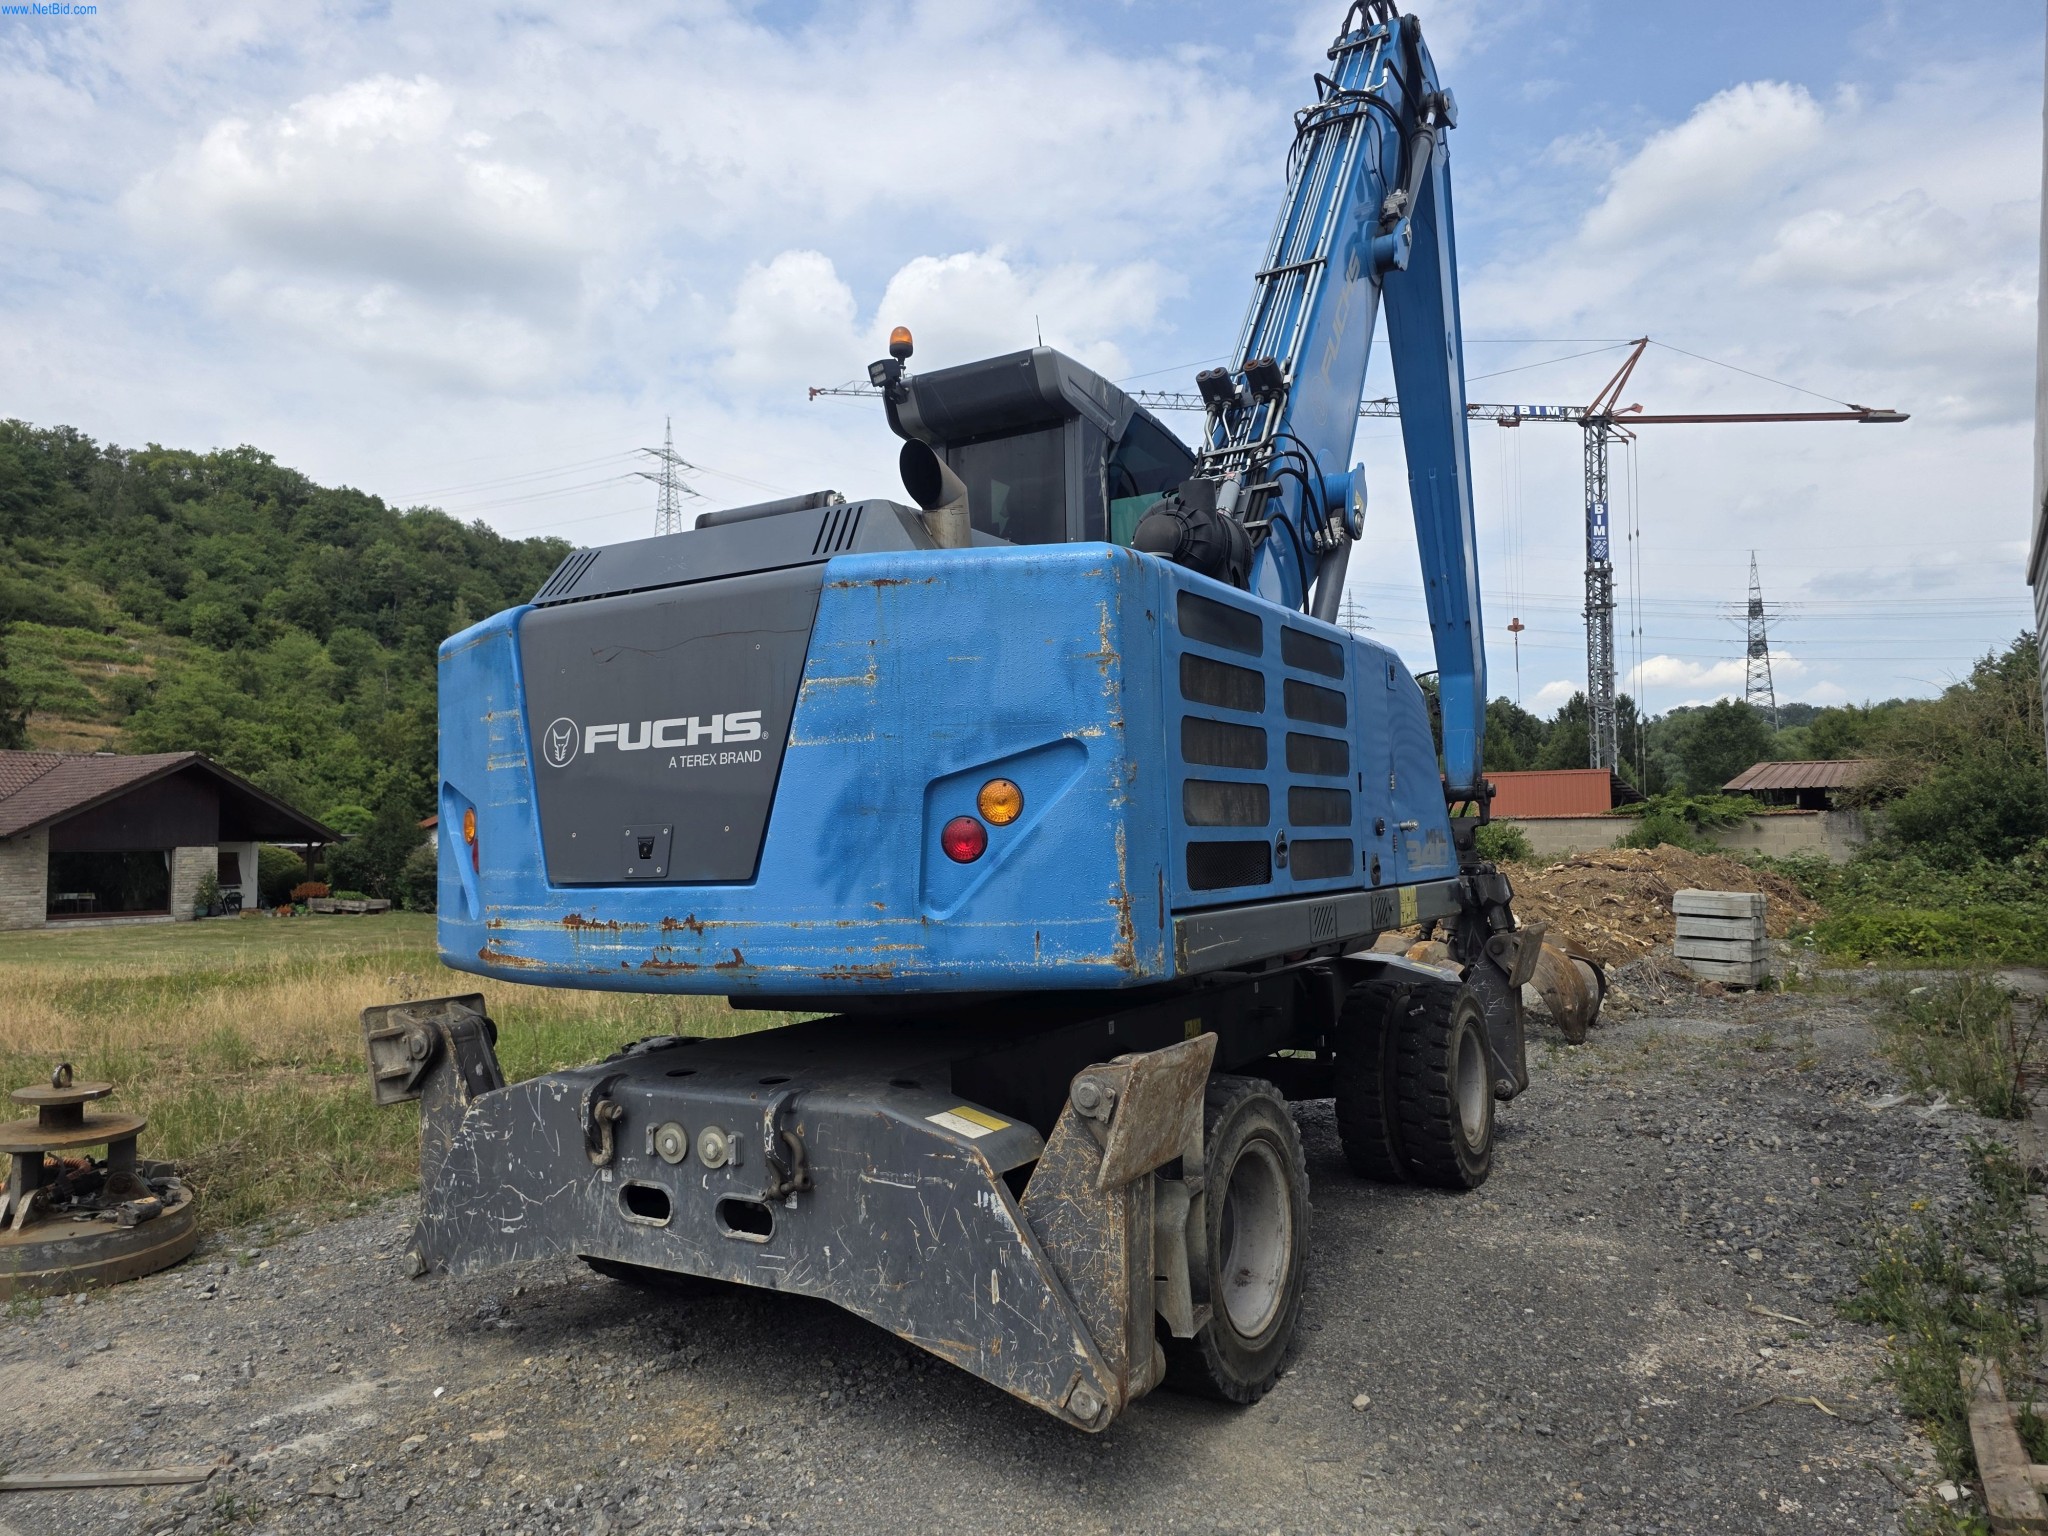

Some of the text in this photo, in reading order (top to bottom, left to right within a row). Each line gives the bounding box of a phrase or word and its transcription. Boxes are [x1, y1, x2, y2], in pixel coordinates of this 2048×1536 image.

[1519, 406, 1560, 416] BIM
[1593, 503, 1606, 536] BIM
[668, 750, 762, 769] A TEREX BRAND
